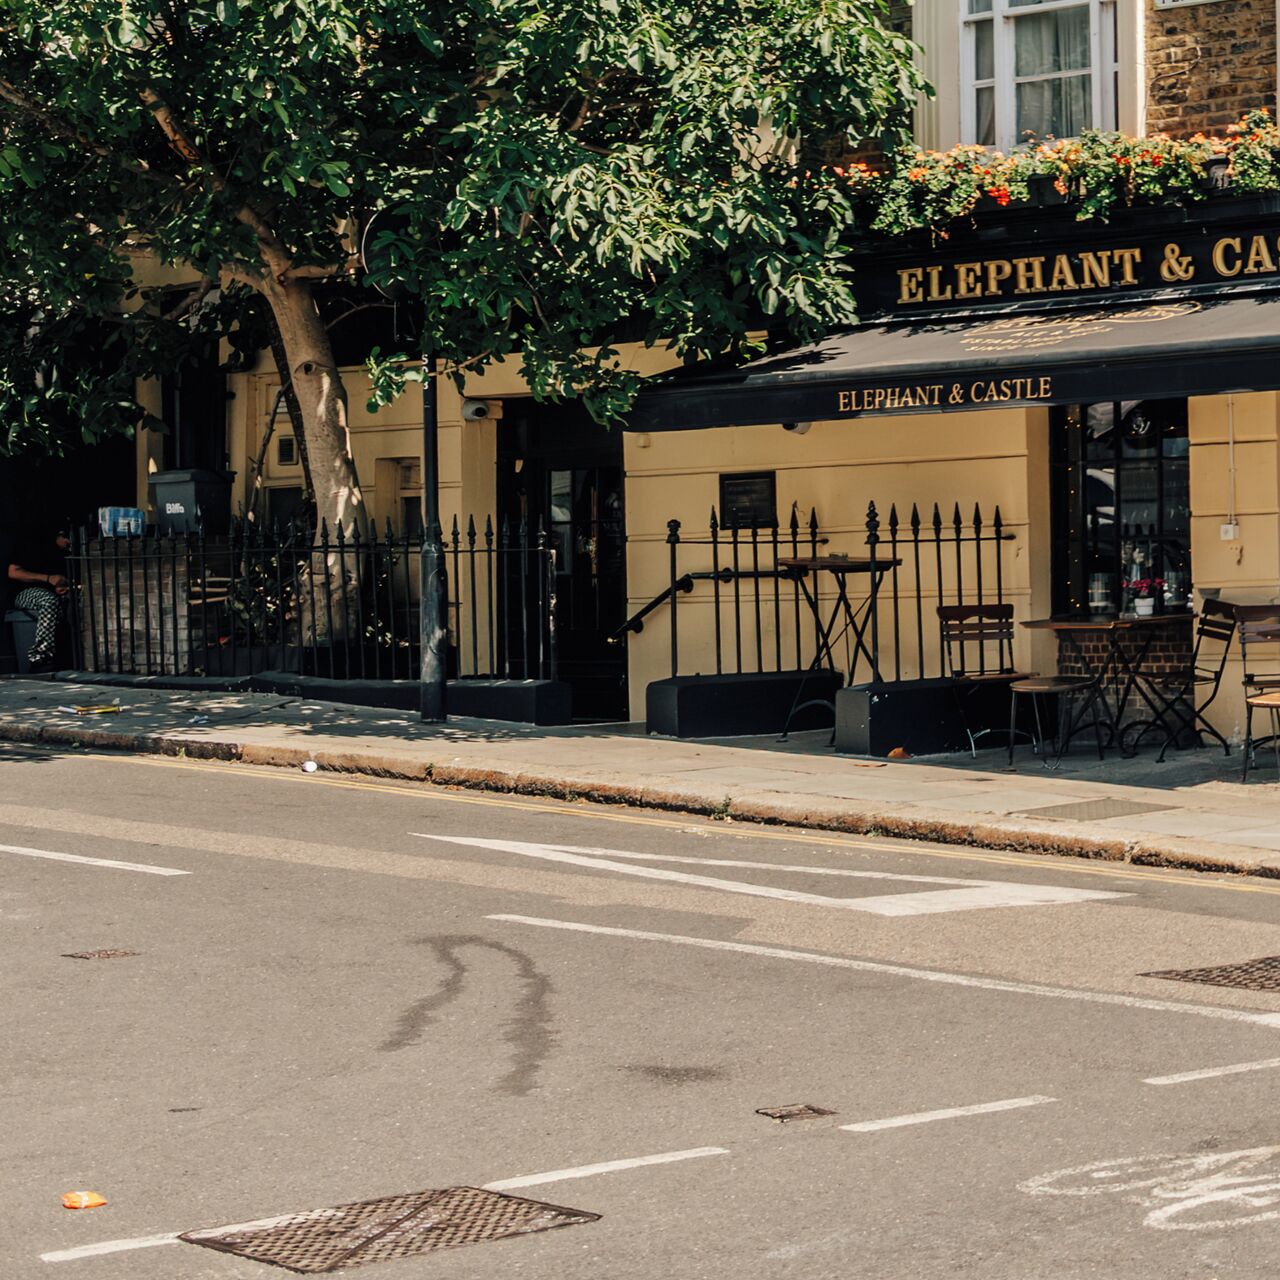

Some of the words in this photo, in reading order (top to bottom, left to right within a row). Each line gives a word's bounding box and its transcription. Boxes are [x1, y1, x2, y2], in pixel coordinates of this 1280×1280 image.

[897, 247, 1142, 305] ELEPHANT
[1159, 242, 1195, 281] &
[838, 384, 943, 412] ELEPHANT
[948, 383, 964, 404] &
[970, 376, 1052, 403] CASTLE
